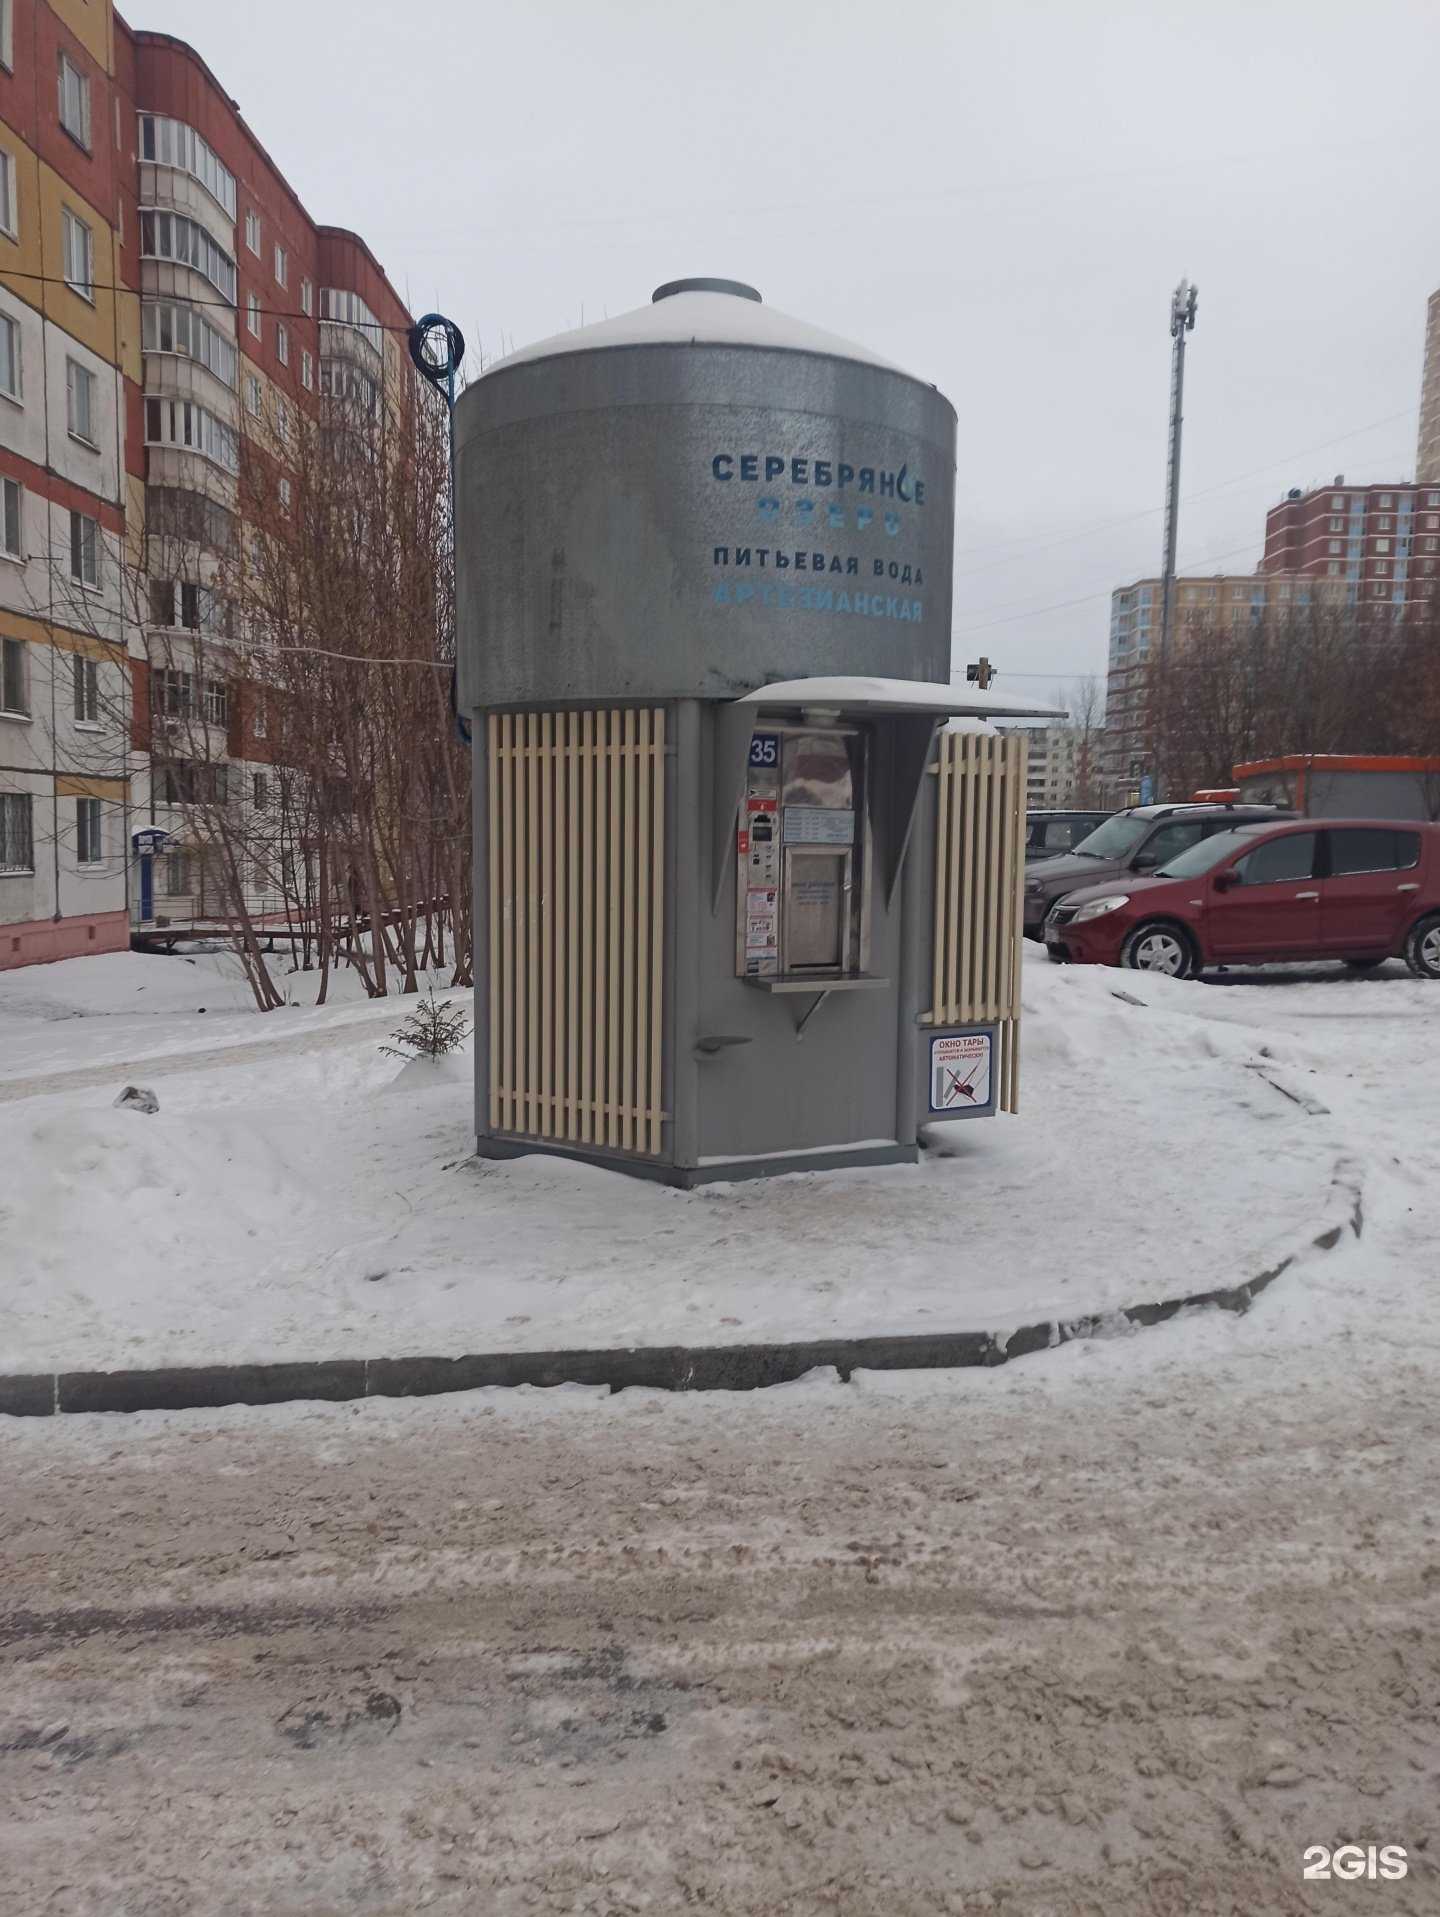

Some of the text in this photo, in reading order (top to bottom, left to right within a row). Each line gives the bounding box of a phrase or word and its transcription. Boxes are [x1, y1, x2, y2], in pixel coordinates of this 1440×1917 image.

[713, 547, 923, 586] ПИТЬЕВАЯ ВОДА
[751, 740, 776, 763] 35
[939, 1038, 984, 1049] ОКНО ТАРЫ
